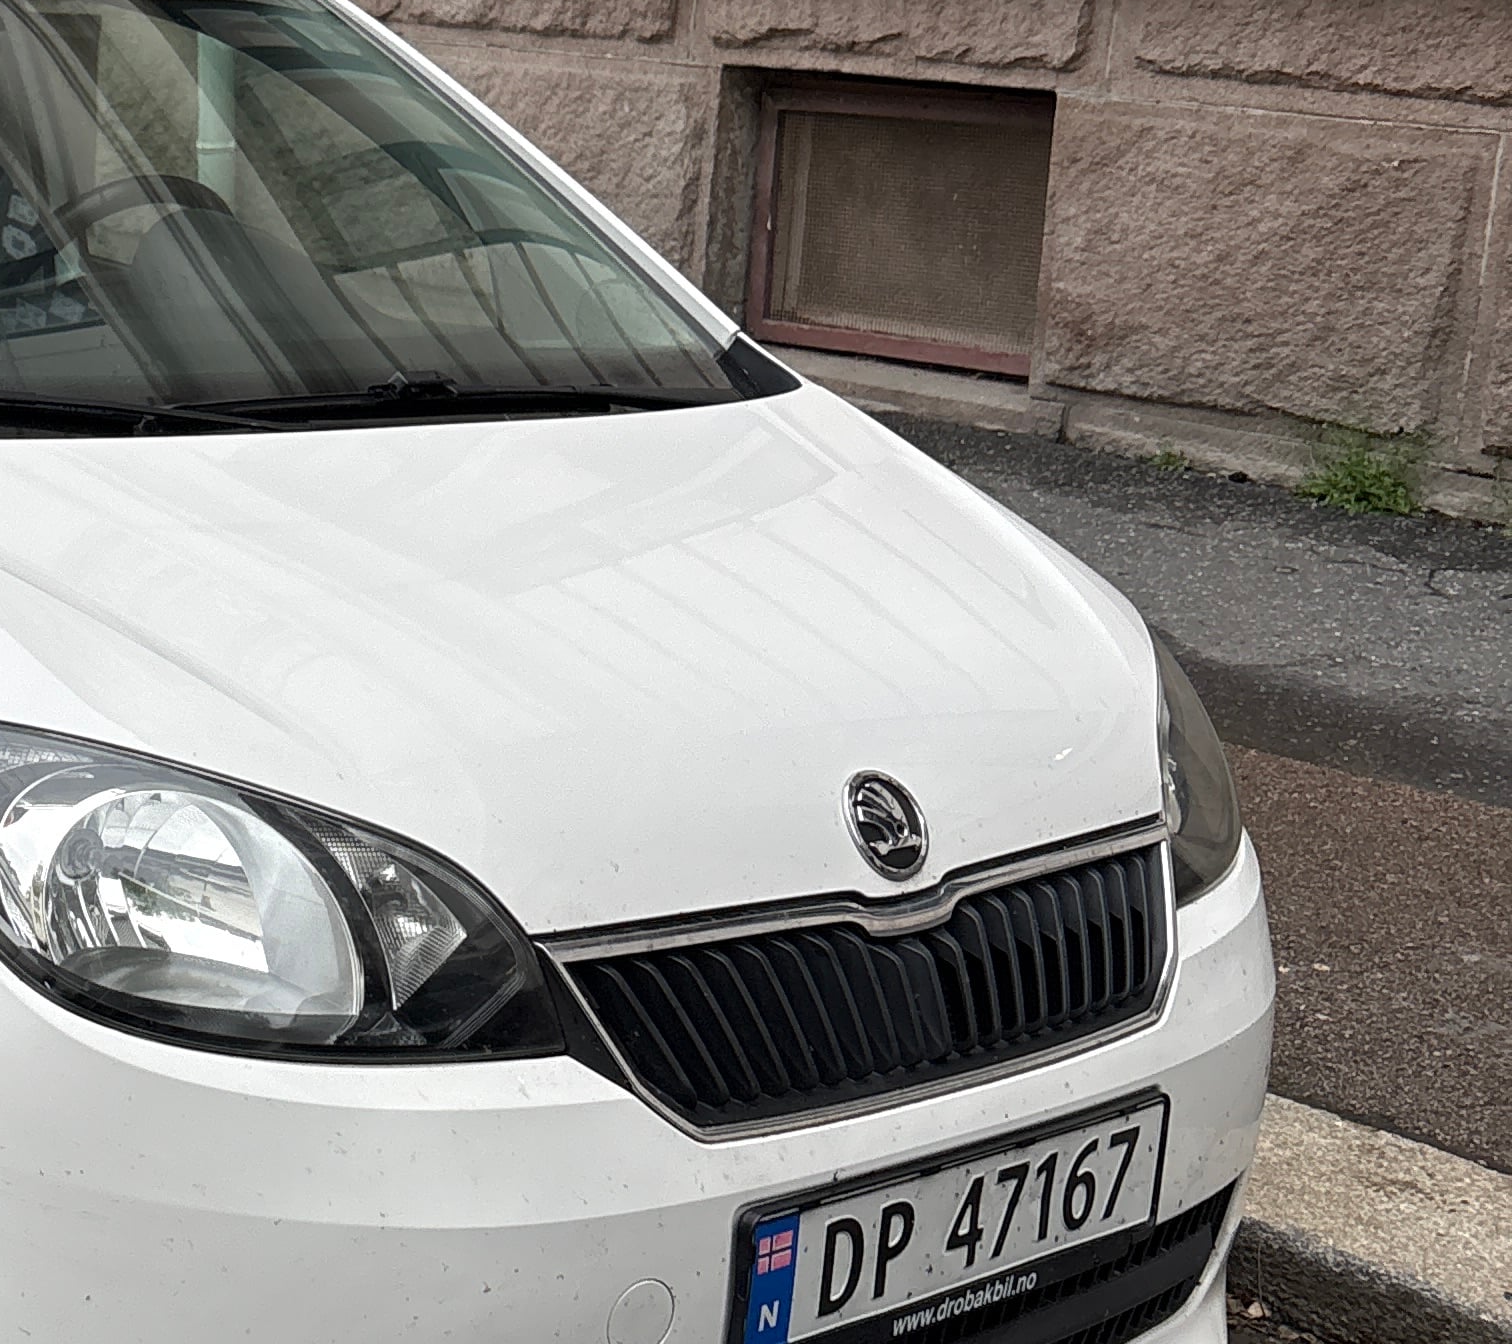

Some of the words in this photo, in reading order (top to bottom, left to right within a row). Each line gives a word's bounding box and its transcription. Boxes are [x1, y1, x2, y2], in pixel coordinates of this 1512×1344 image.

[816, 1198, 915, 1318] DP
[945, 1124, 1141, 1269] 47167
[757, 1299, 780, 1333] N
[892, 1272, 1037, 1337] www.drobakbil.no
